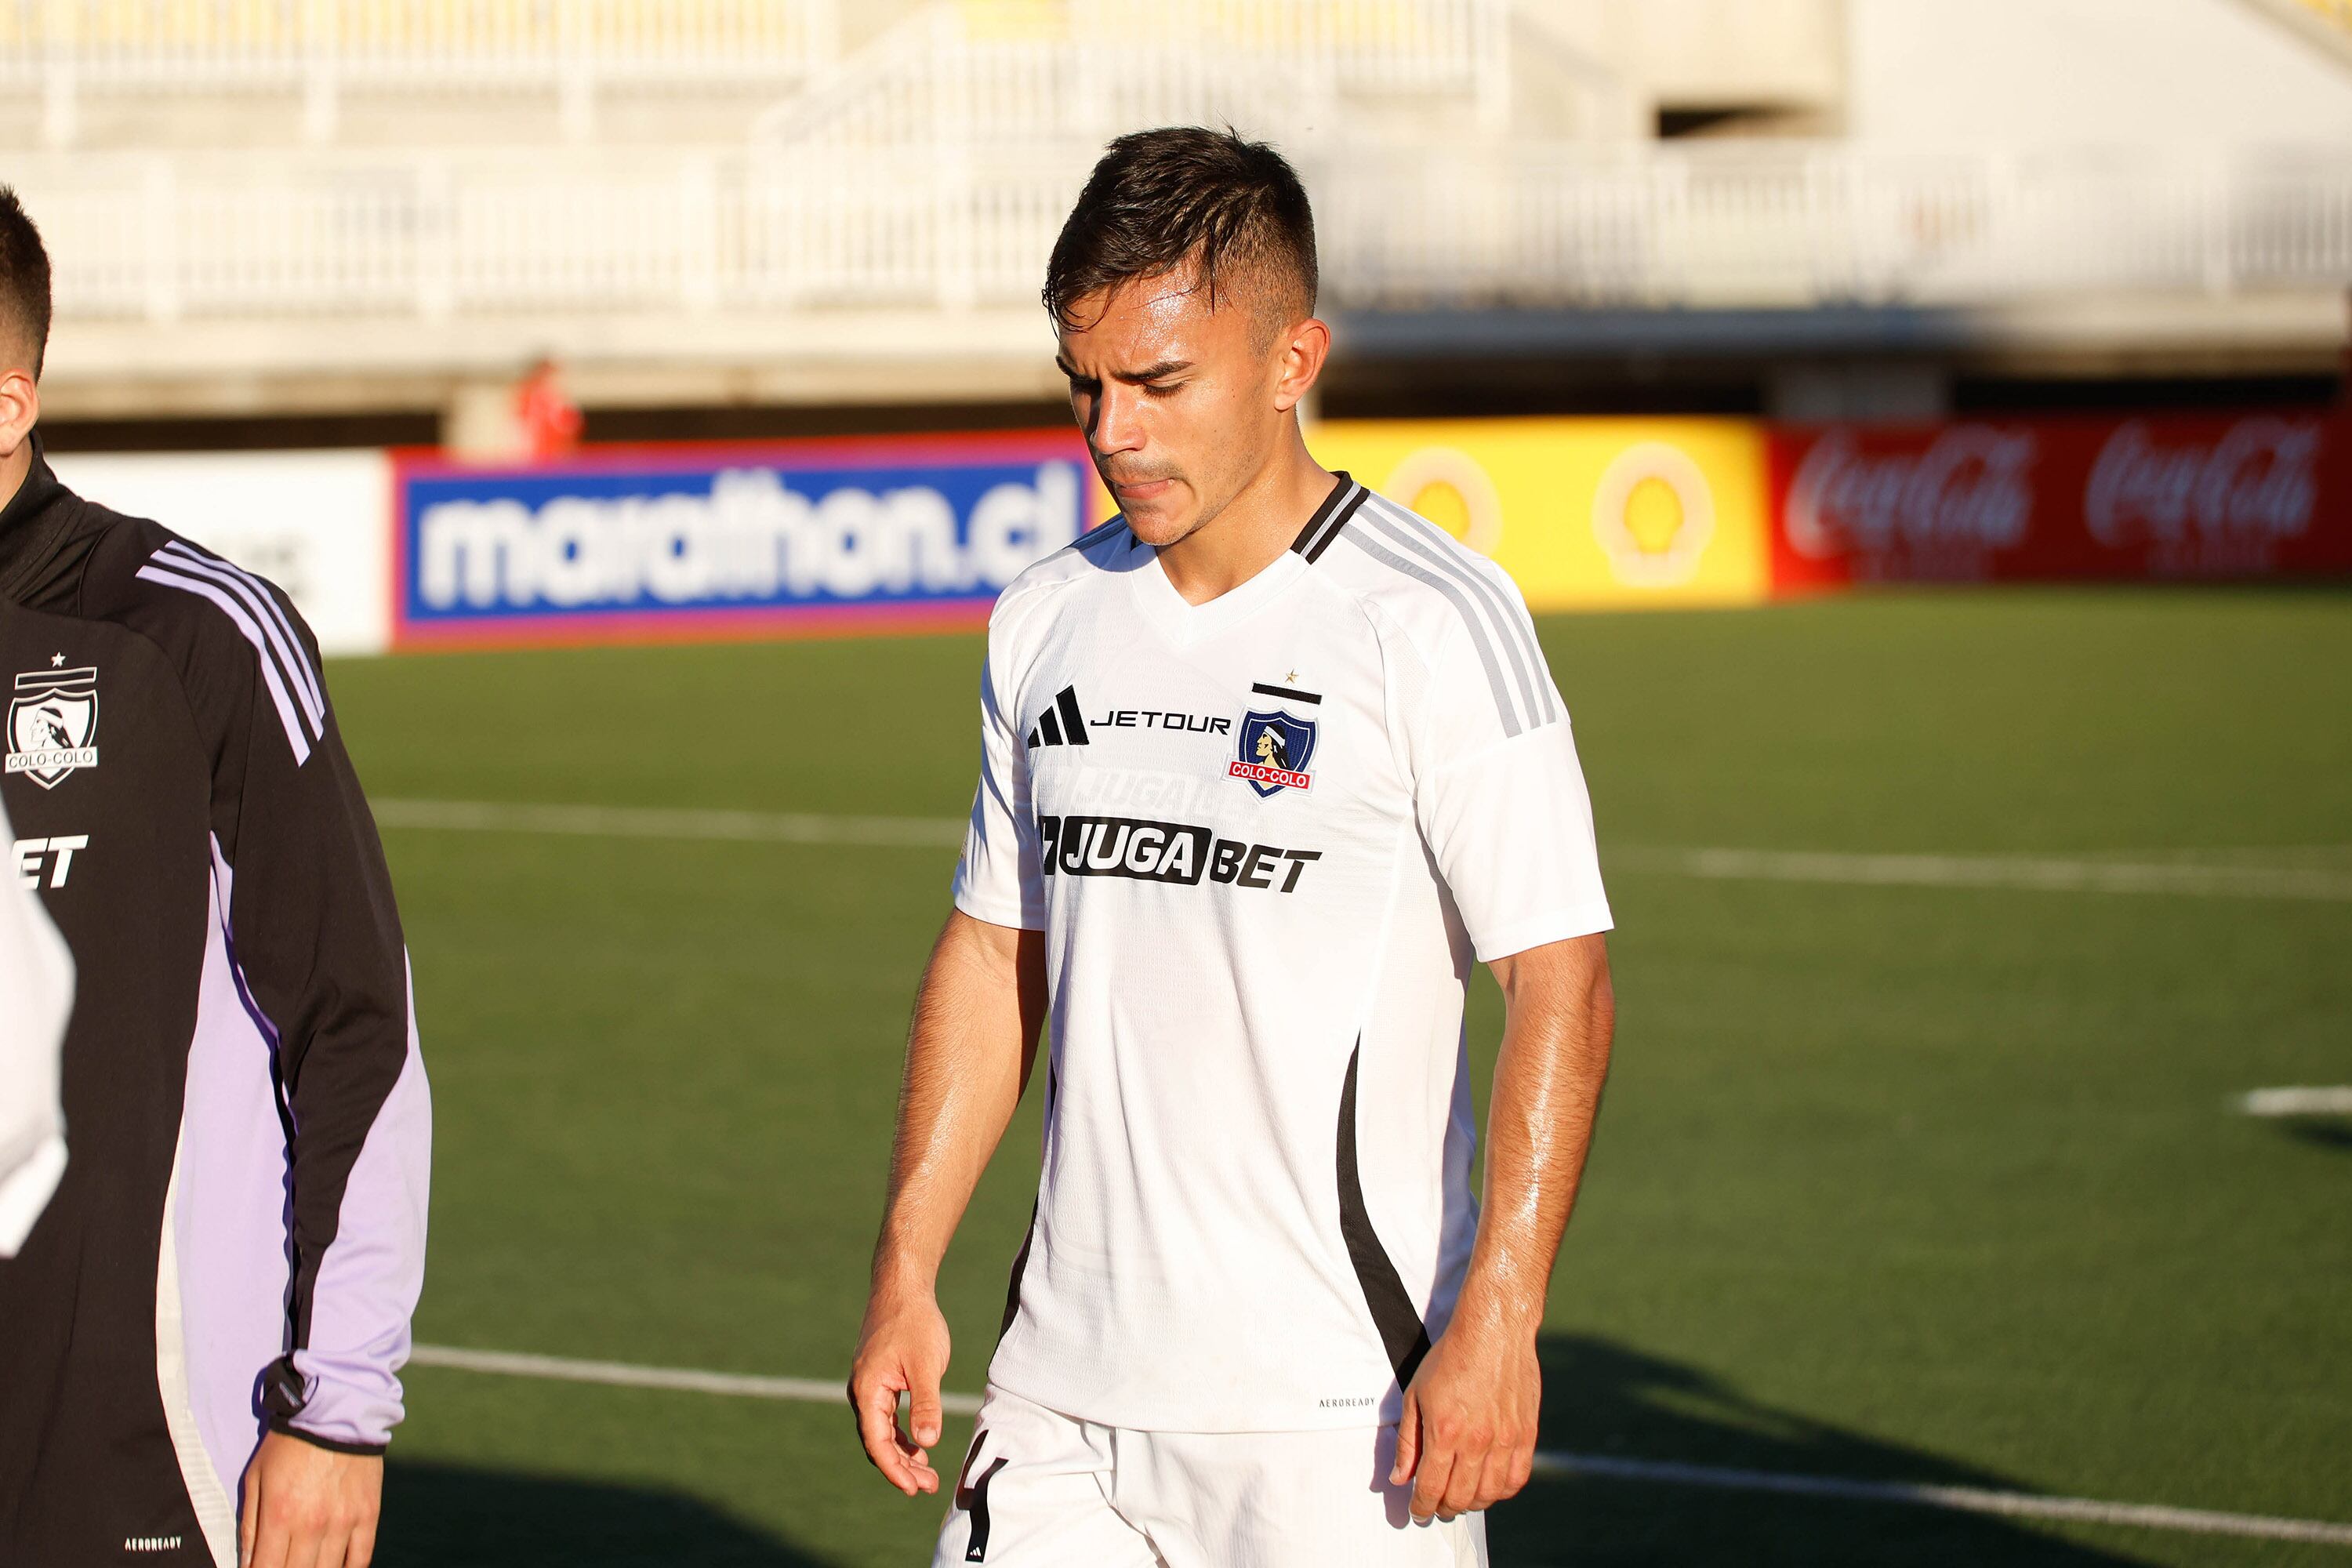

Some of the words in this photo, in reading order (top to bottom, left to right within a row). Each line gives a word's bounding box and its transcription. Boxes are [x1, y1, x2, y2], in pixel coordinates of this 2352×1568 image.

[419, 461, 1077, 608] marathon.cl
[1091, 711, 1231, 735] JETOUR
[9, 750, 93, 768] COLO-COLO
[1232, 764, 1307, 787] COLO-COLO
[1319, 1397, 1375, 1408] AEROREADY
[956, 1429, 1009, 1563] 4
[125, 1536, 181, 1552] AEROREADY
